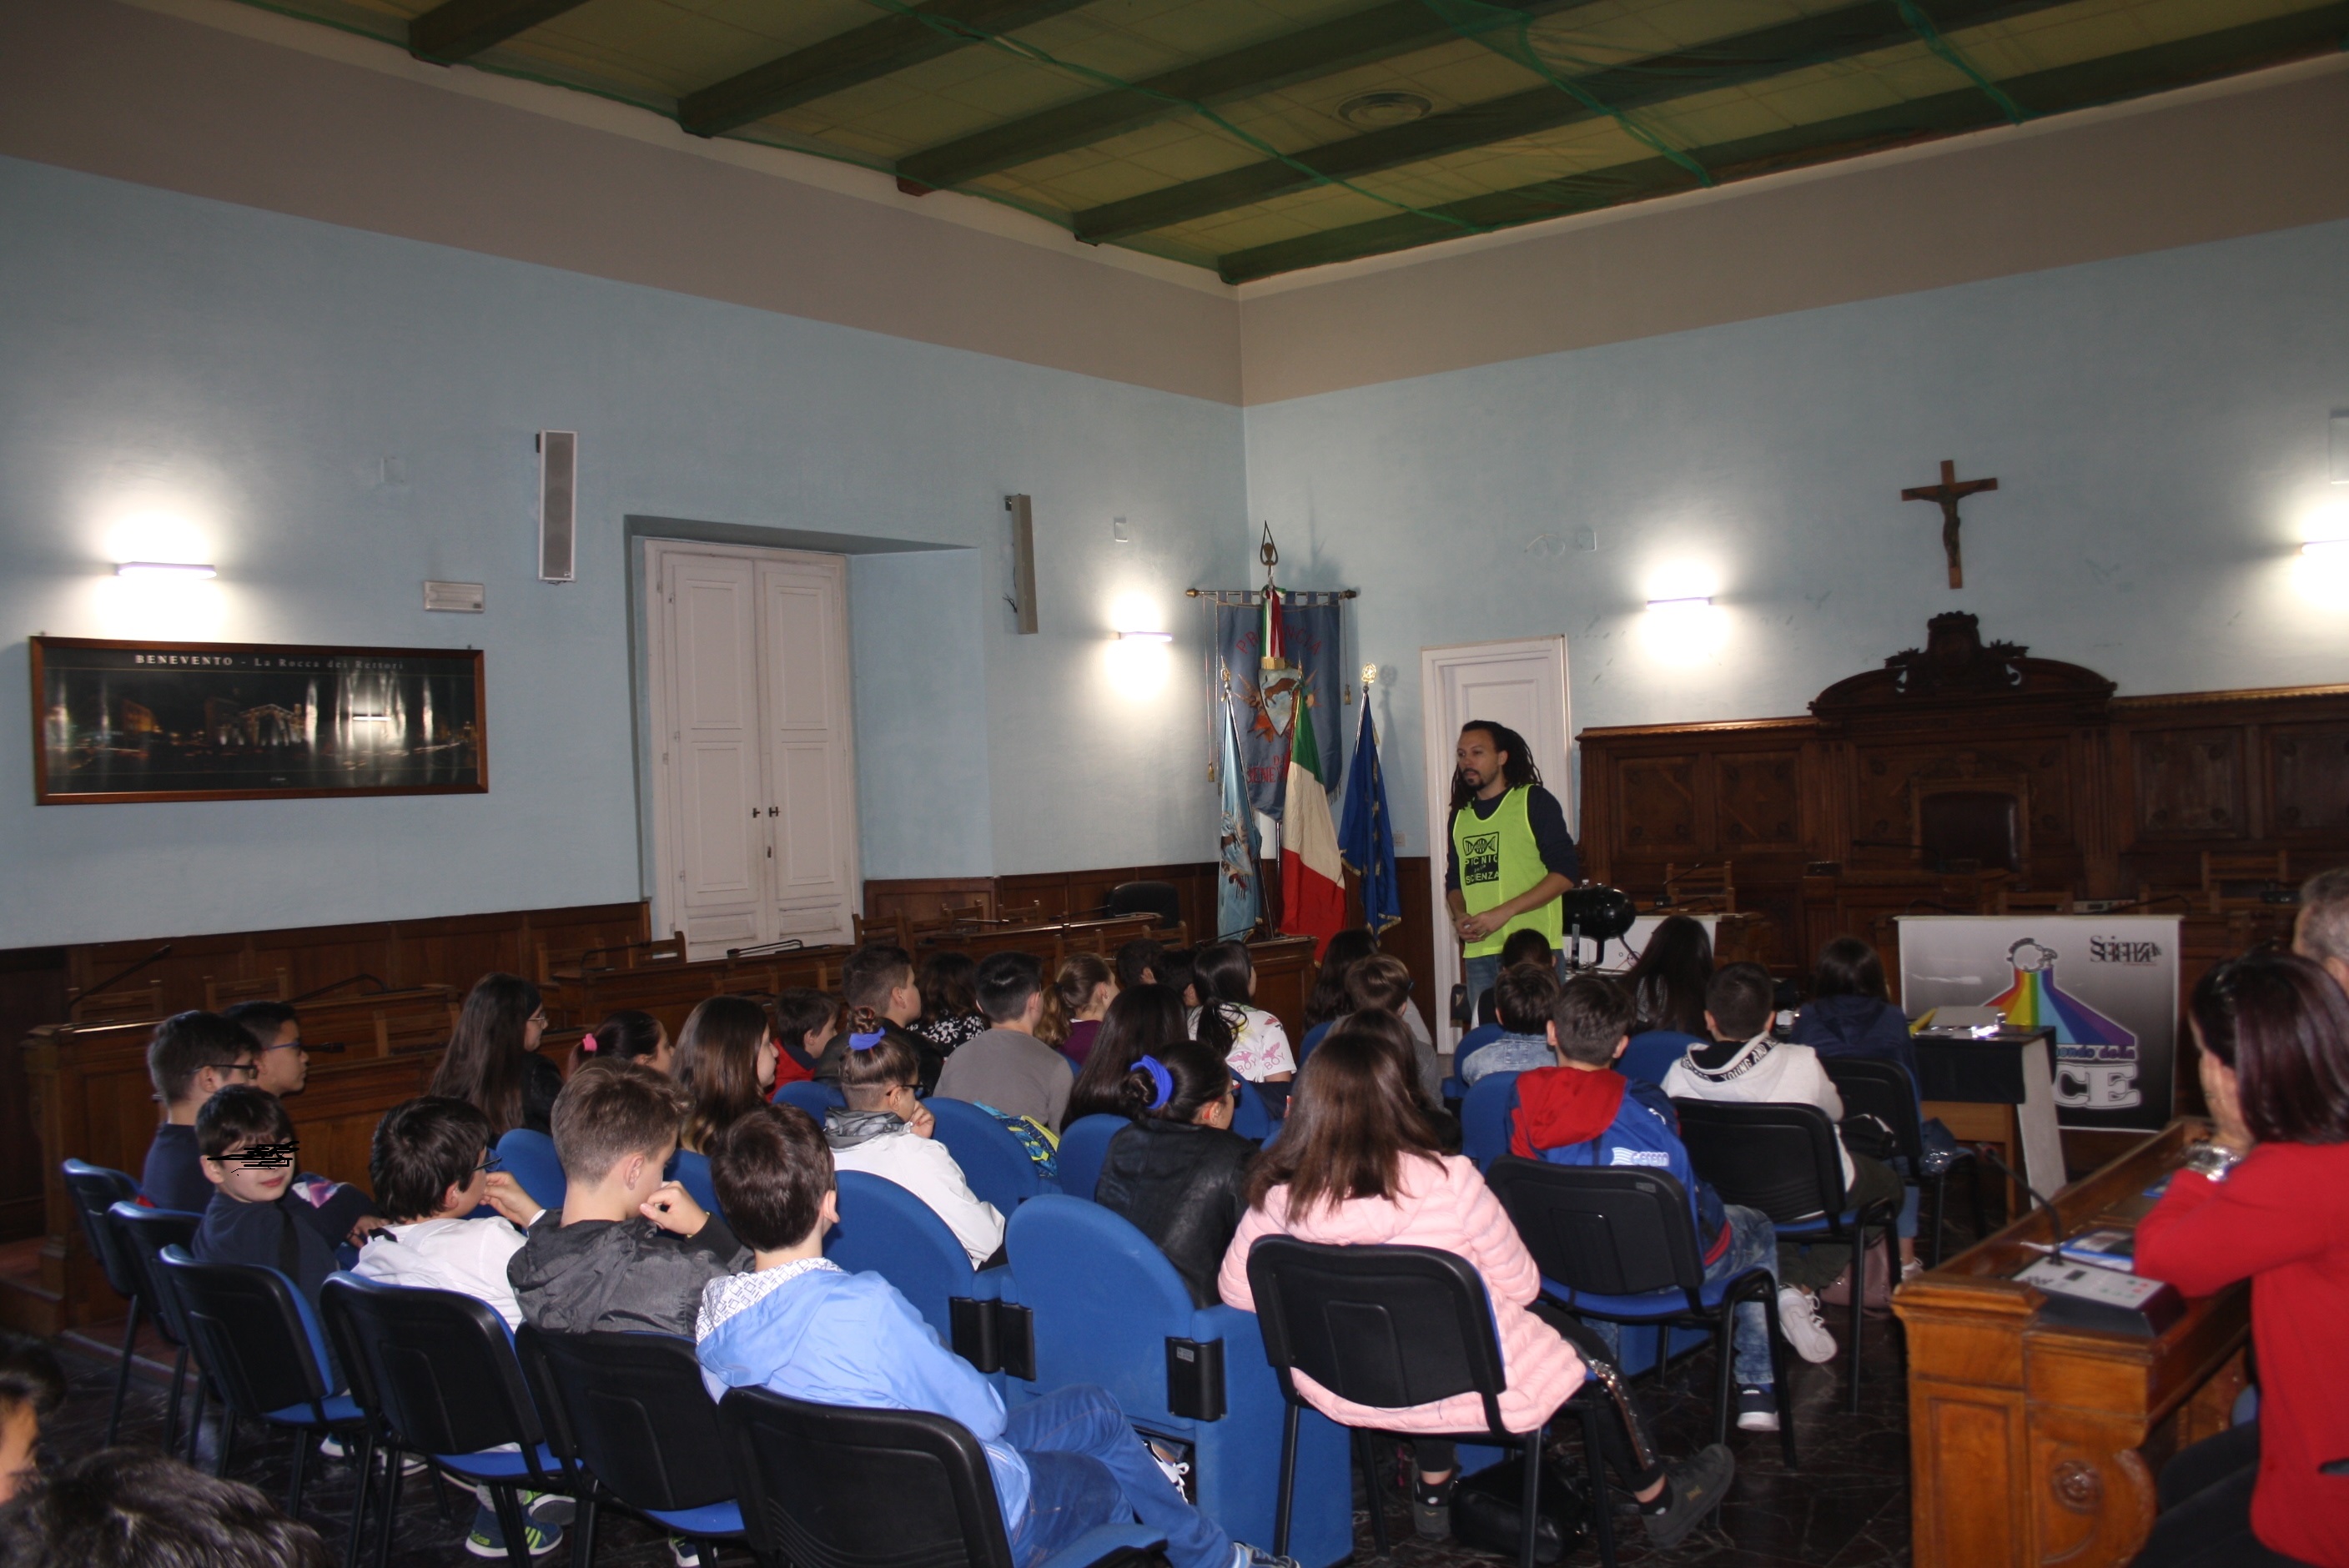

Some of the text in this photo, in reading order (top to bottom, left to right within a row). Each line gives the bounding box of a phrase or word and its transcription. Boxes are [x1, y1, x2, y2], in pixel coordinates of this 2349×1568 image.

[135, 655, 233, 665] BENEVENTO
[254, 657, 270, 666] La
[279, 658, 319, 668] Rocca
[1466, 871, 1499, 884] SCIENZA
[1236, 1058, 1257, 1073] BOY
[1265, 1053, 1285, 1070] BOY
[1720, 1058, 1752, 1081] YOUNG
